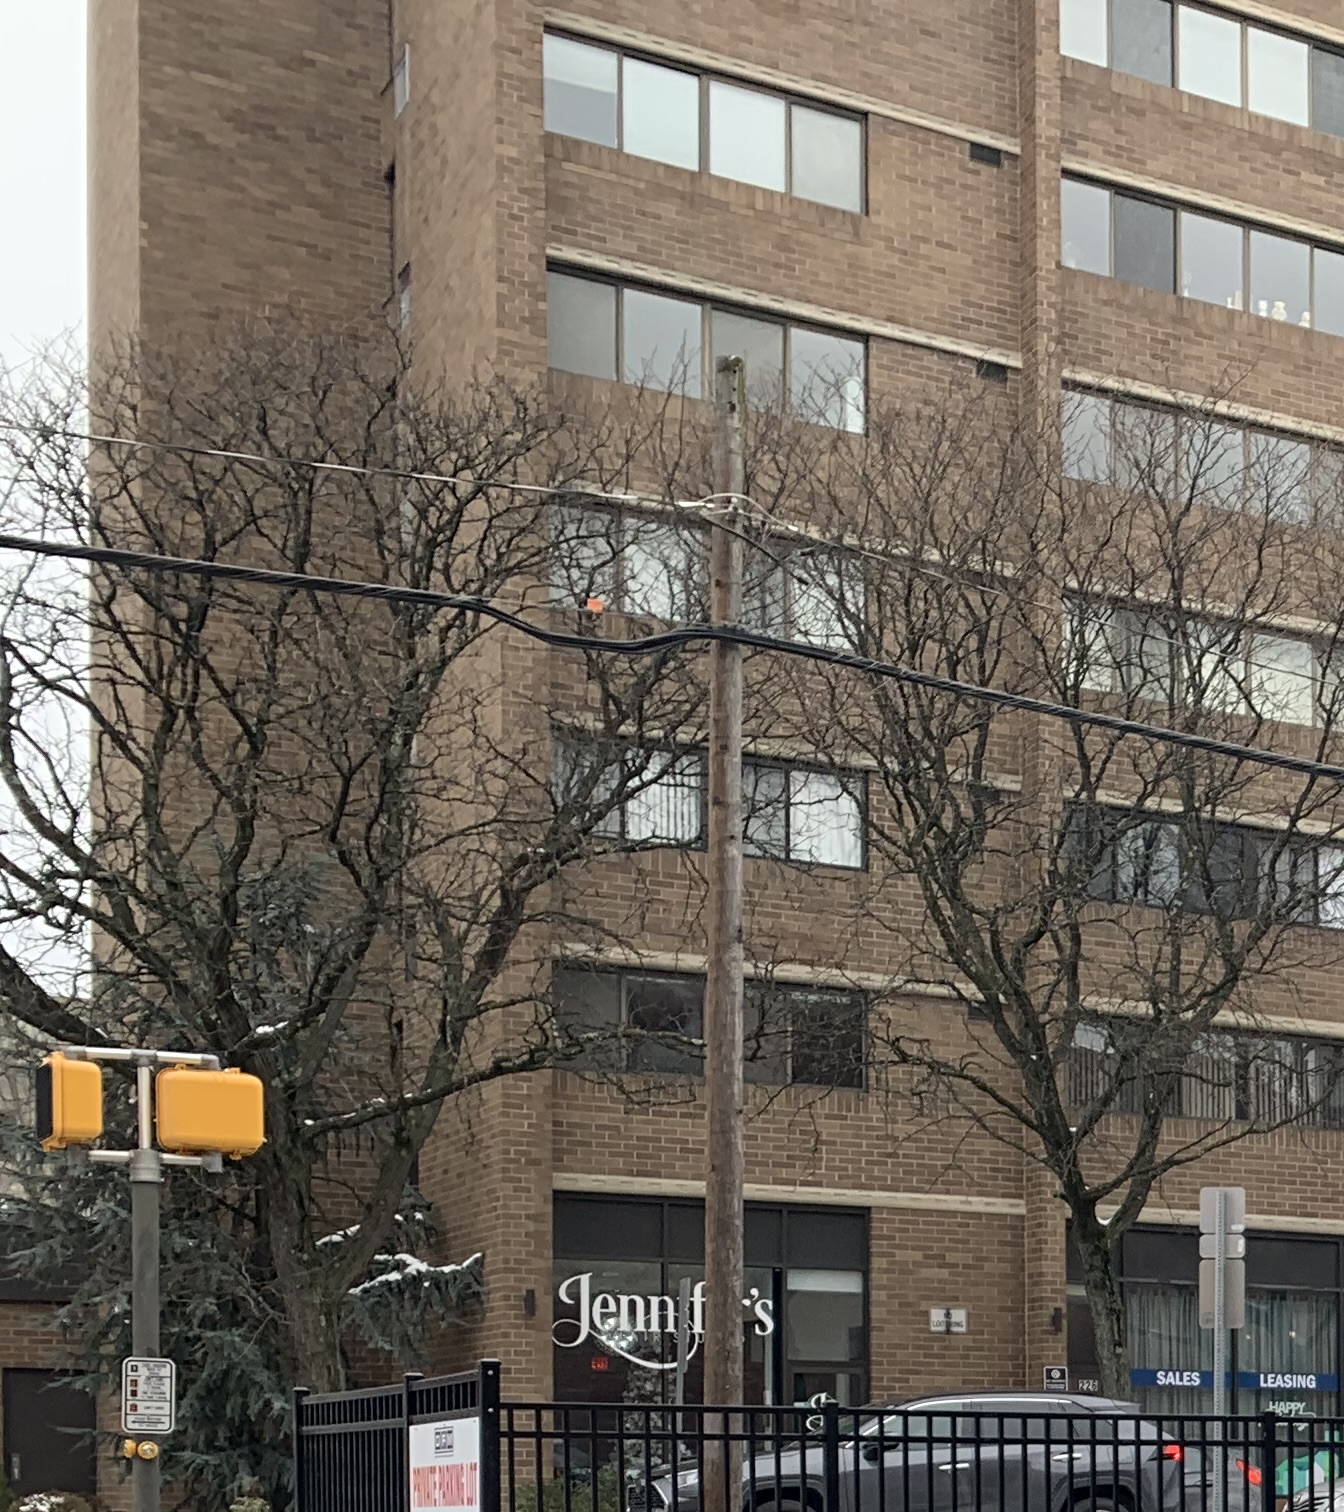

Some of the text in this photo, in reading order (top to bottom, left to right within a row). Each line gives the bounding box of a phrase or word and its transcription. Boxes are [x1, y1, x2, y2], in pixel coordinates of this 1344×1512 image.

[1156, 1370, 1201, 1387] SALES
[1259, 1373, 1317, 1389] LEASING
[1268, 1400, 1307, 1417] HAPPY
